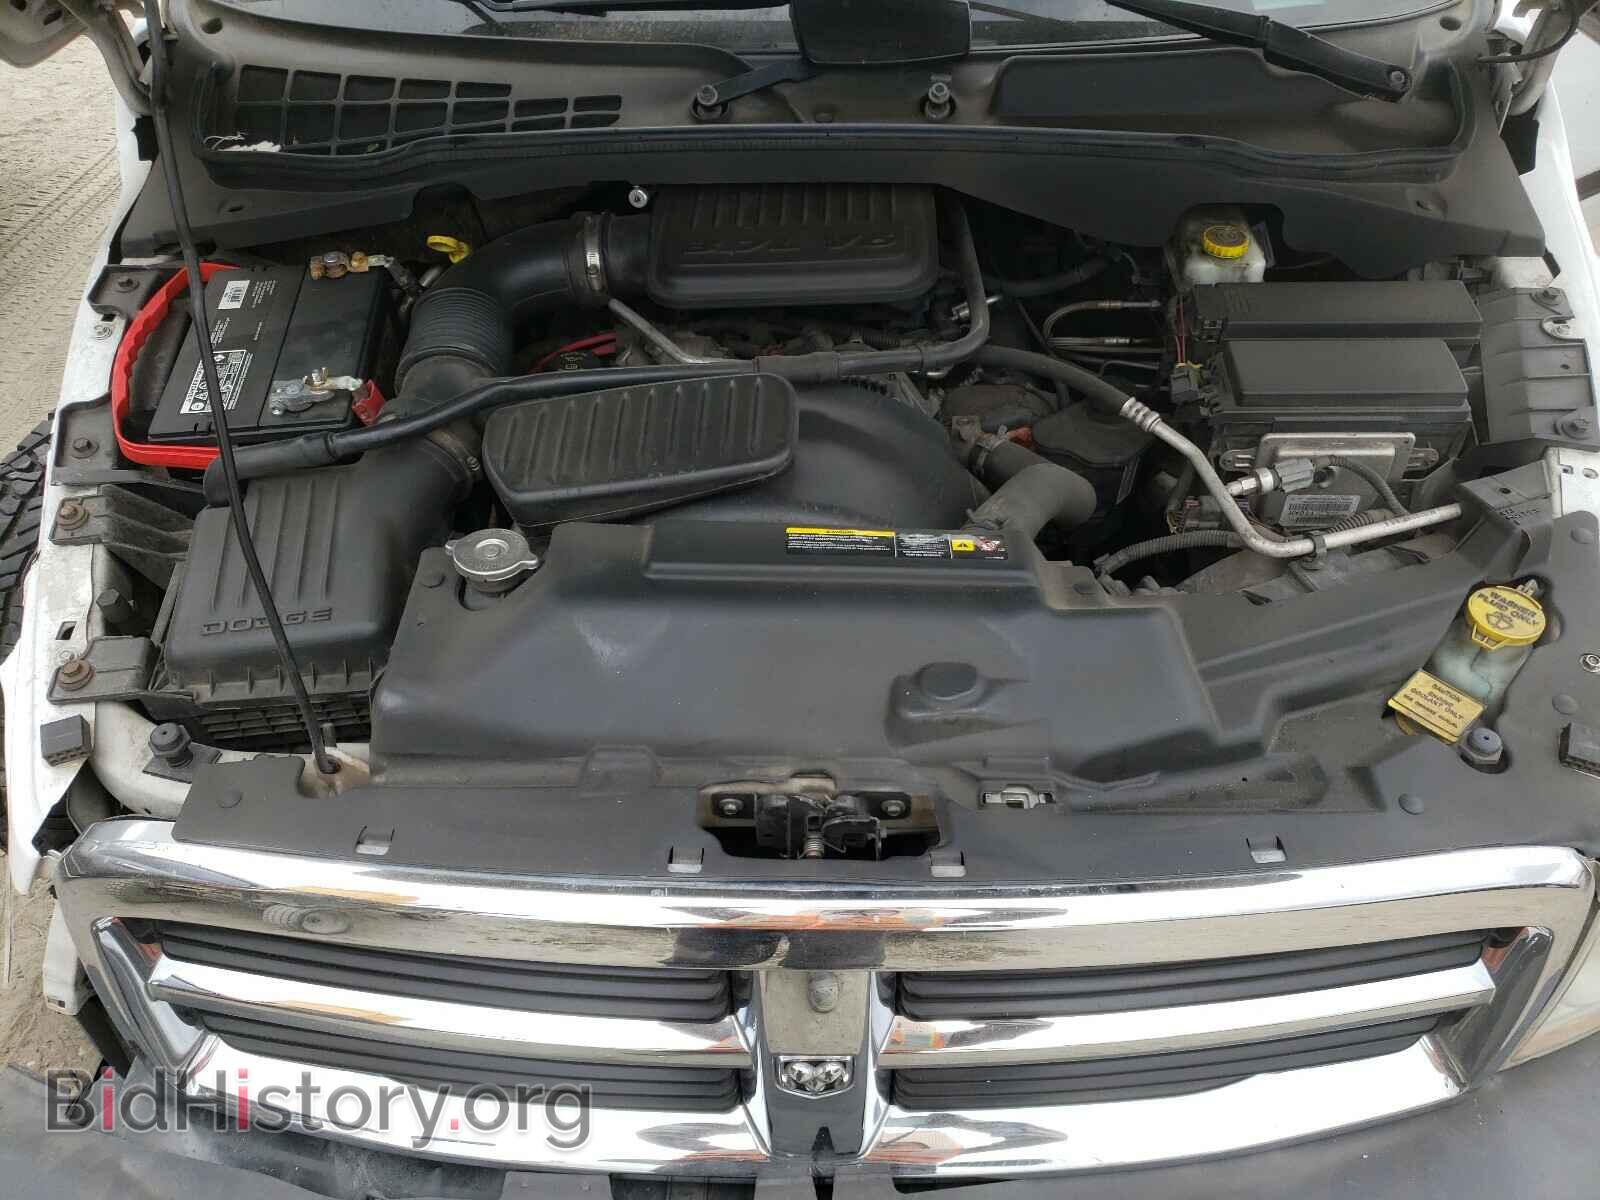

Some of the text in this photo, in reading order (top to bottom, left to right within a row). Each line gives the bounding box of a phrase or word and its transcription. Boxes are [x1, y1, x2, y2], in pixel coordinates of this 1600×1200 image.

[1477, 593, 1539, 627] FLUID ONLY
[1490, 591, 1536, 617] WASHER
[1431, 683, 1461, 703] CAUTION
